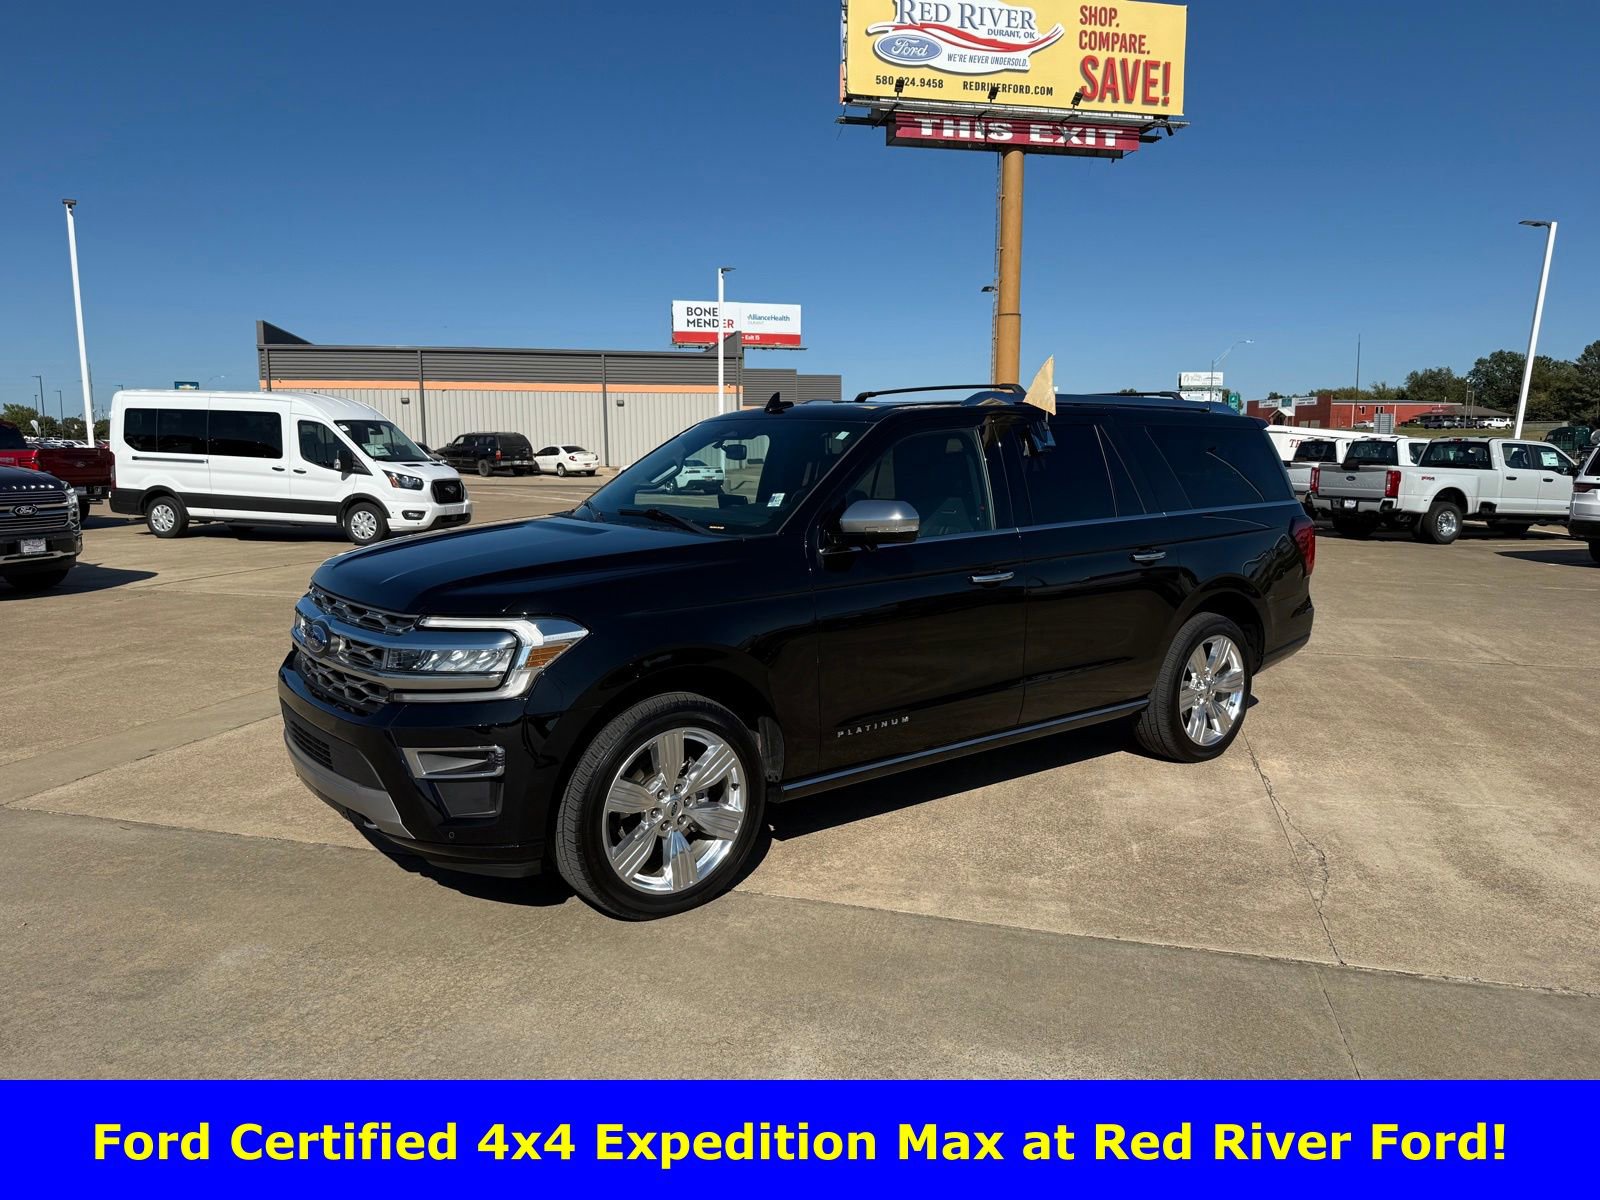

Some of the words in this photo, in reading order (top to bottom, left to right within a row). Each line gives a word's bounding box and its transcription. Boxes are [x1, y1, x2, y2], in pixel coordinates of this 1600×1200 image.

[897, 0, 951, 25] RED
[957, 3, 1036, 30] RIVER
[1079, 5, 1120, 28] SHOP.
[987, 28, 1022, 39] DURANT,
[1023, 31, 1036, 40] OK
[1079, 30, 1151, 55] COMPARE.
[891, 38, 929, 57] Ford
[947, 53, 967, 63] WE'RE
[968, 54, 989, 65] NEVER
[990, 55, 1029, 67] UNDERSOLD.
[1079, 55, 1171, 107] SAVE!
[914, 118, 1014, 141] THIS
[1029, 124, 1123, 147] EXIT
[686, 306, 719, 317] BONE
[747, 313, 791, 321] AllianceHealth
[837, 716, 909, 738] PLATINUM
